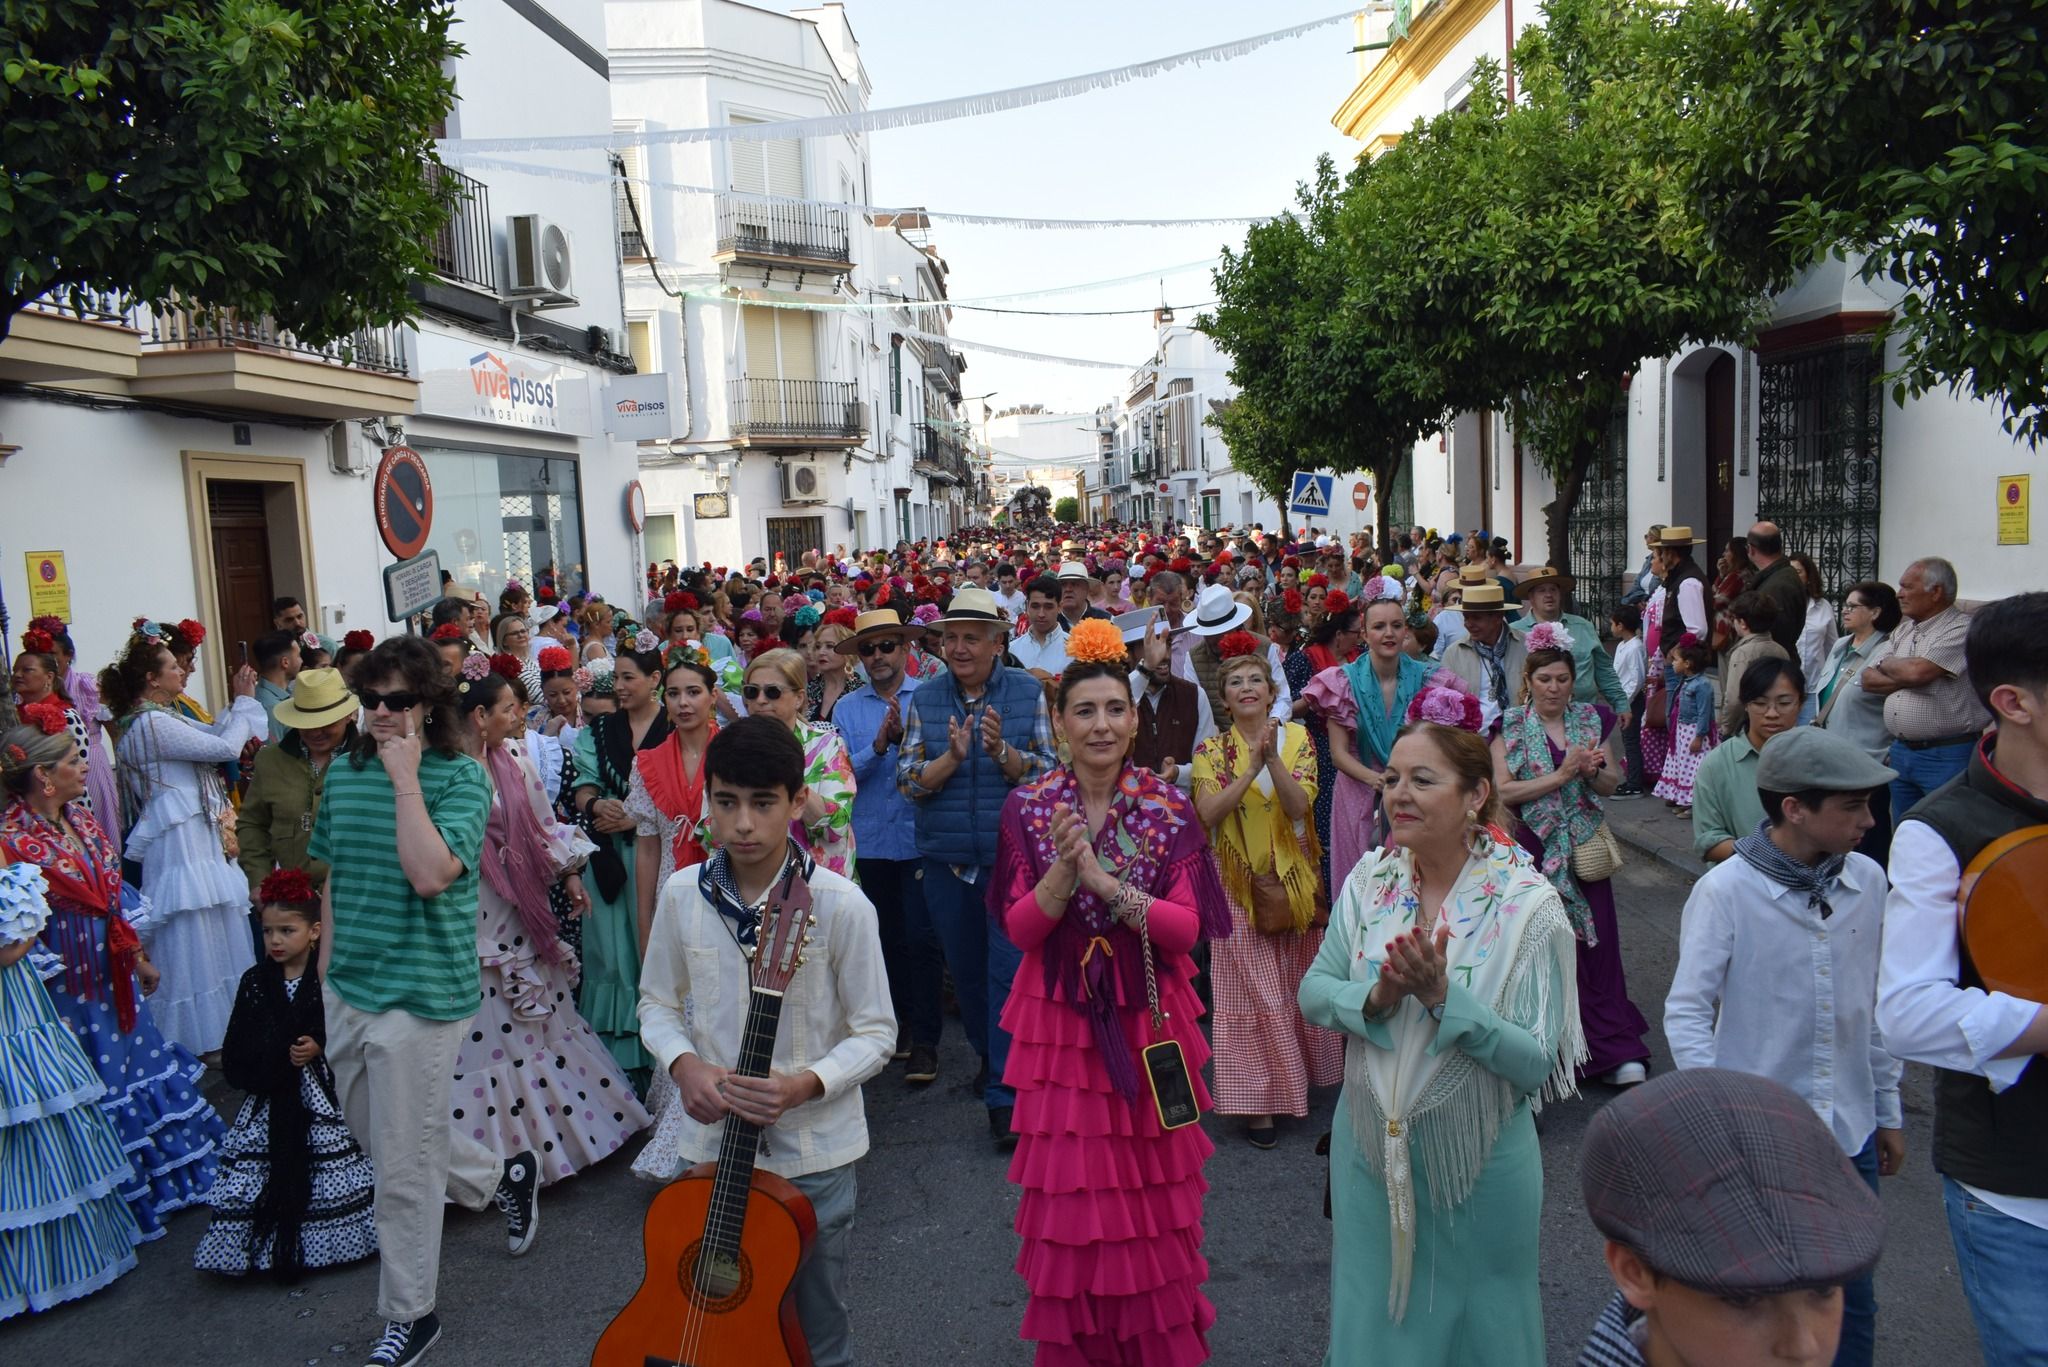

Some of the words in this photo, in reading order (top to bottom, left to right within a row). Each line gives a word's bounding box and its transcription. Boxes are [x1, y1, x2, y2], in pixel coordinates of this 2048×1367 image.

[470, 362, 554, 409] vivapisos
[474, 405, 556, 427] INMOBILIARIA
[617, 402, 665, 413] vivapisos
[391, 450, 406, 465] CARGA
